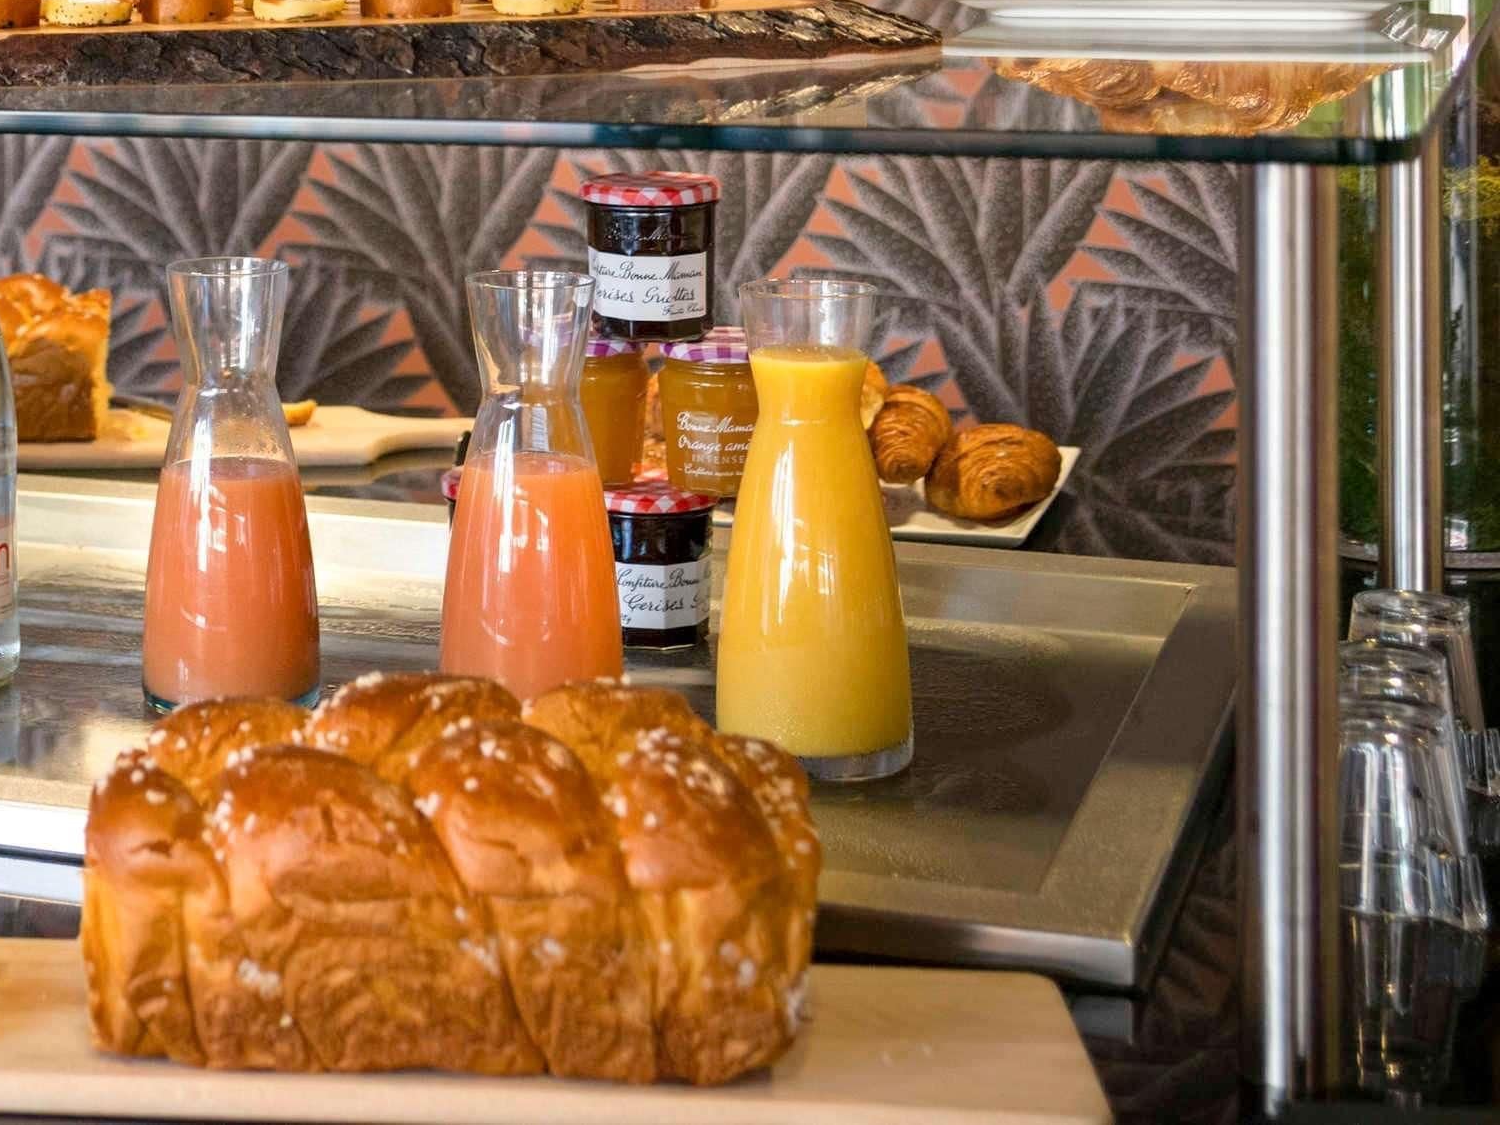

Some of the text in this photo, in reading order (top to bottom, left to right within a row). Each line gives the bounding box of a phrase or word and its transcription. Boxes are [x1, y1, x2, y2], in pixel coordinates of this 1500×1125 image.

[620, 260, 657, 281] Bonne
[596, 284, 635, 303] erises
[713, 415, 756, 433] Mama
[678, 434, 722, 454] Orange
[617, 569, 667, 592] Confiture
[623, 594, 685, 613] Cerises
